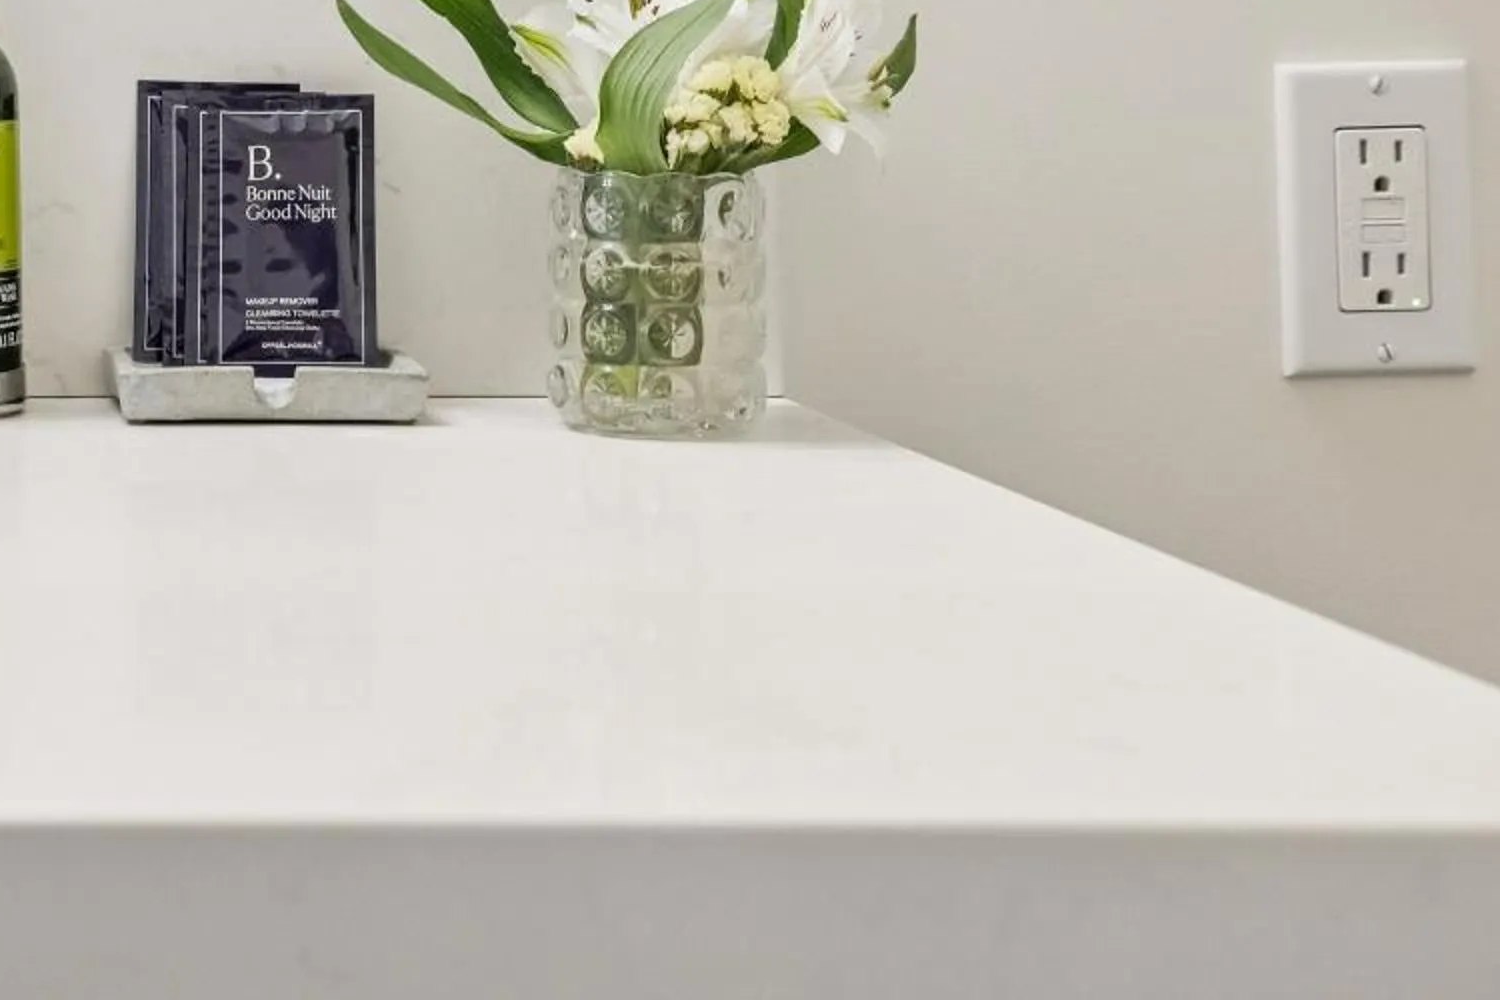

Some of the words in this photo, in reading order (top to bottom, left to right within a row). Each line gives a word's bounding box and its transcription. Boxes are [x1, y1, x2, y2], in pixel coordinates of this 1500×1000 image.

[247, 145, 282, 181] B.
[246, 185, 297, 202] Bonne
[297, 184, 331, 201] Nuit
[245, 203, 292, 221] Good
[294, 203, 337, 223] Night
